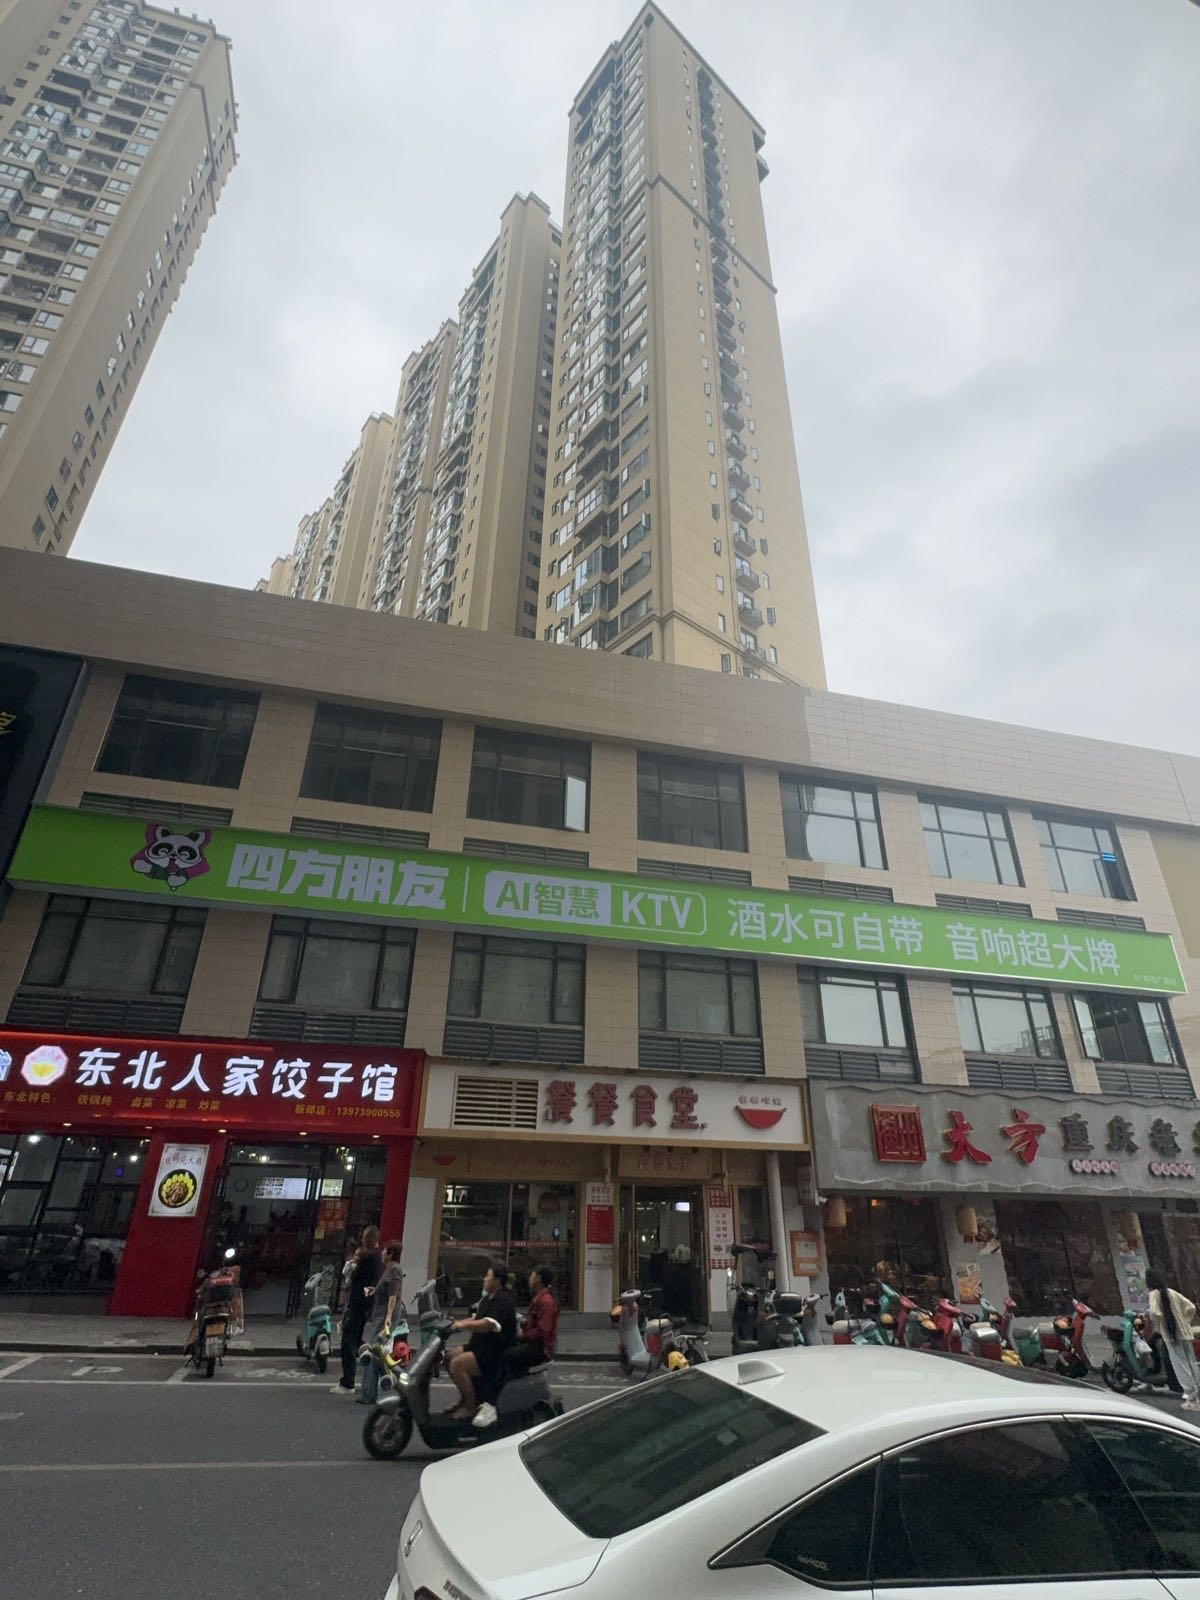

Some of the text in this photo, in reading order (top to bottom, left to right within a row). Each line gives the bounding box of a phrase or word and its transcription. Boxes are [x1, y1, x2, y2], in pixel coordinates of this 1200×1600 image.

[226, 843, 1121, 977] 四方朋友 AI智慧 KTV 酒水可自带 音响超大牌
[75, 1047, 400, 1102] 东北人家饺子馆
[546, 1080, 699, 1129] 餐餐食堂
[941, 1107, 1047, 1164] 大方
